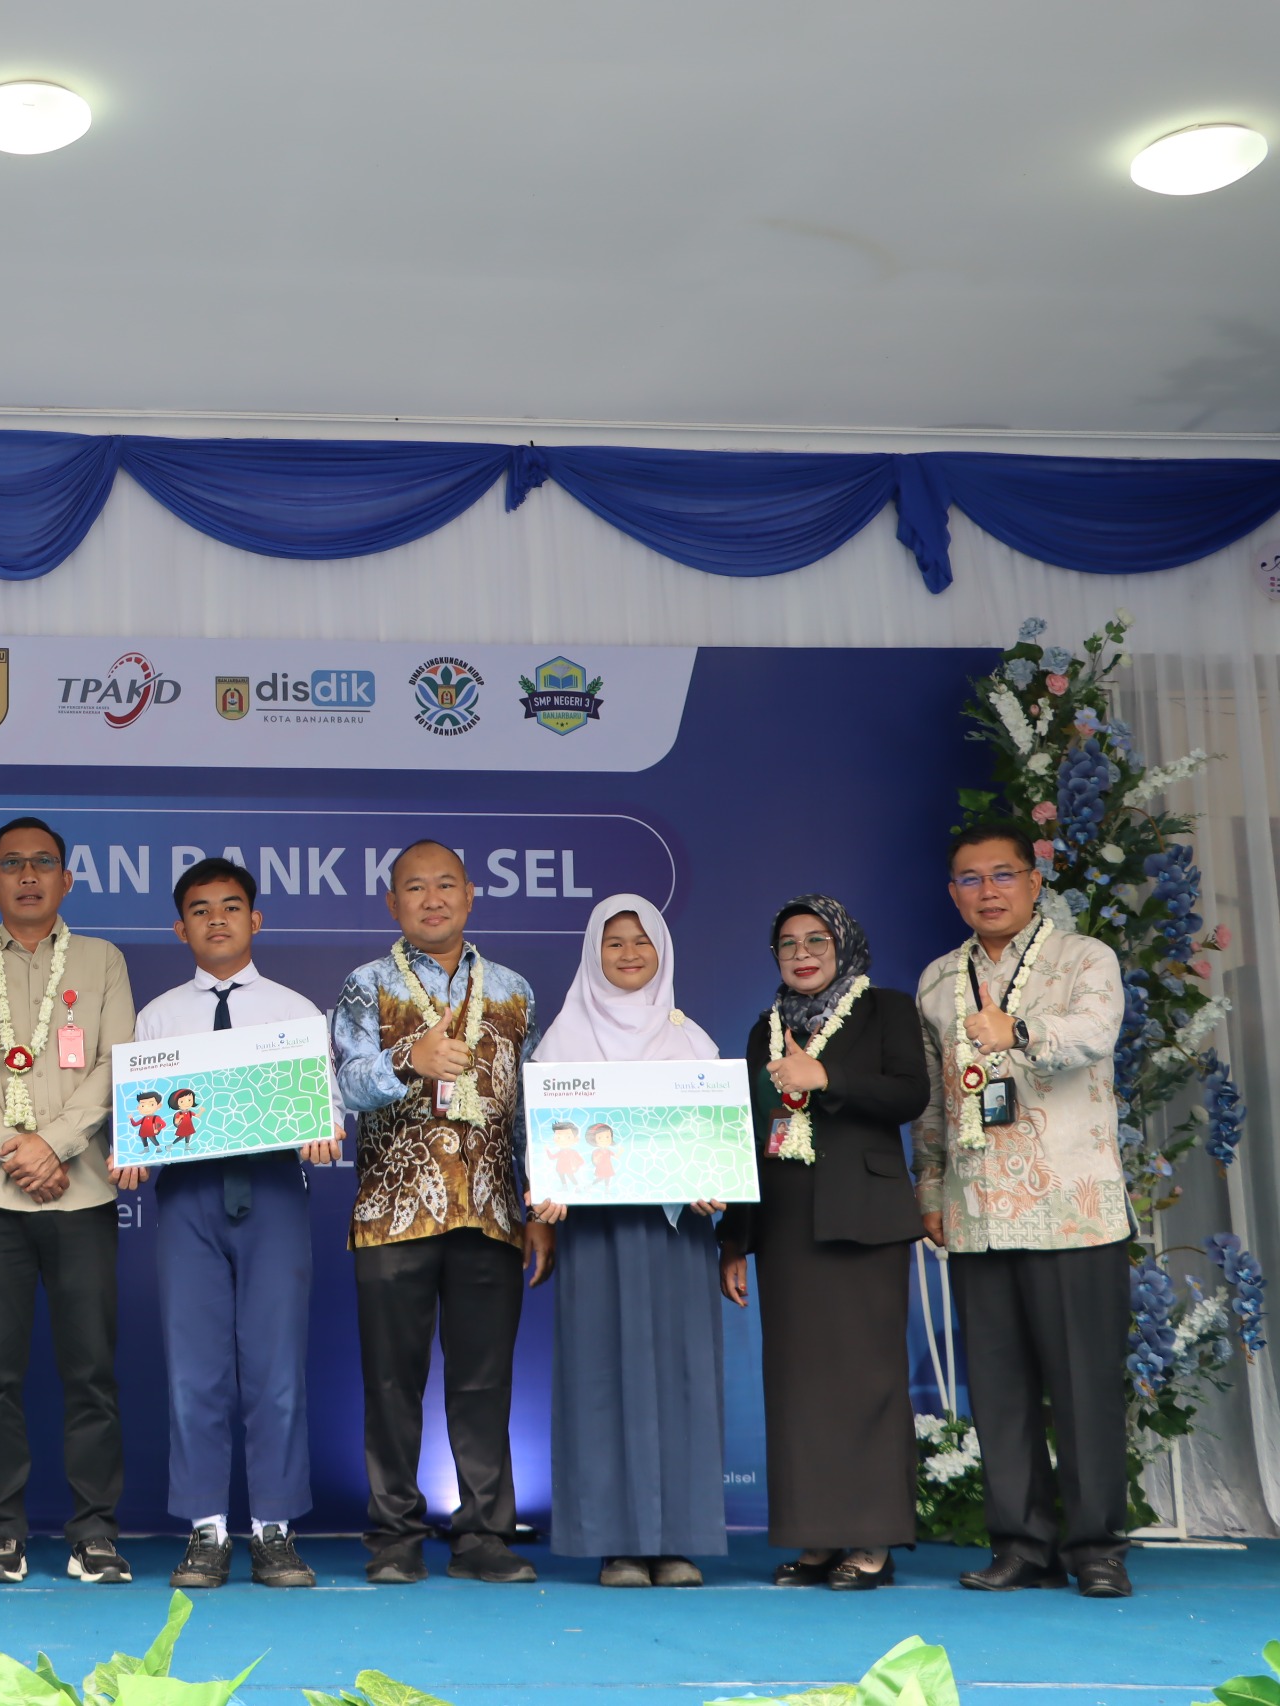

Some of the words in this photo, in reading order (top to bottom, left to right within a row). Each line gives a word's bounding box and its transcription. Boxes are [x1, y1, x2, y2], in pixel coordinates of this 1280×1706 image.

[408, 665, 426, 686] DINAS
[423, 656, 469, 670] LINGKUNGAN
[466, 665, 485, 686] HIDUP
[57, 672, 182, 704] TPAKD
[256, 672, 372, 703] disdik
[533, 696, 552, 707] SMP
[553, 695, 583, 707] NEGERI
[584, 698, 590, 707] 3
[264, 715, 291, 723] KOTA
[296, 716, 364, 724] BANJARBARU
[414, 713, 433, 732] KOTA
[433, 714, 481, 736] BANJARBARU
[542, 711, 582, 720] BANJARBARU
[364, 847, 593, 898] KSEL
[129, 1050, 180, 1067] SimPel
[543, 1078, 596, 1091] SimPel
